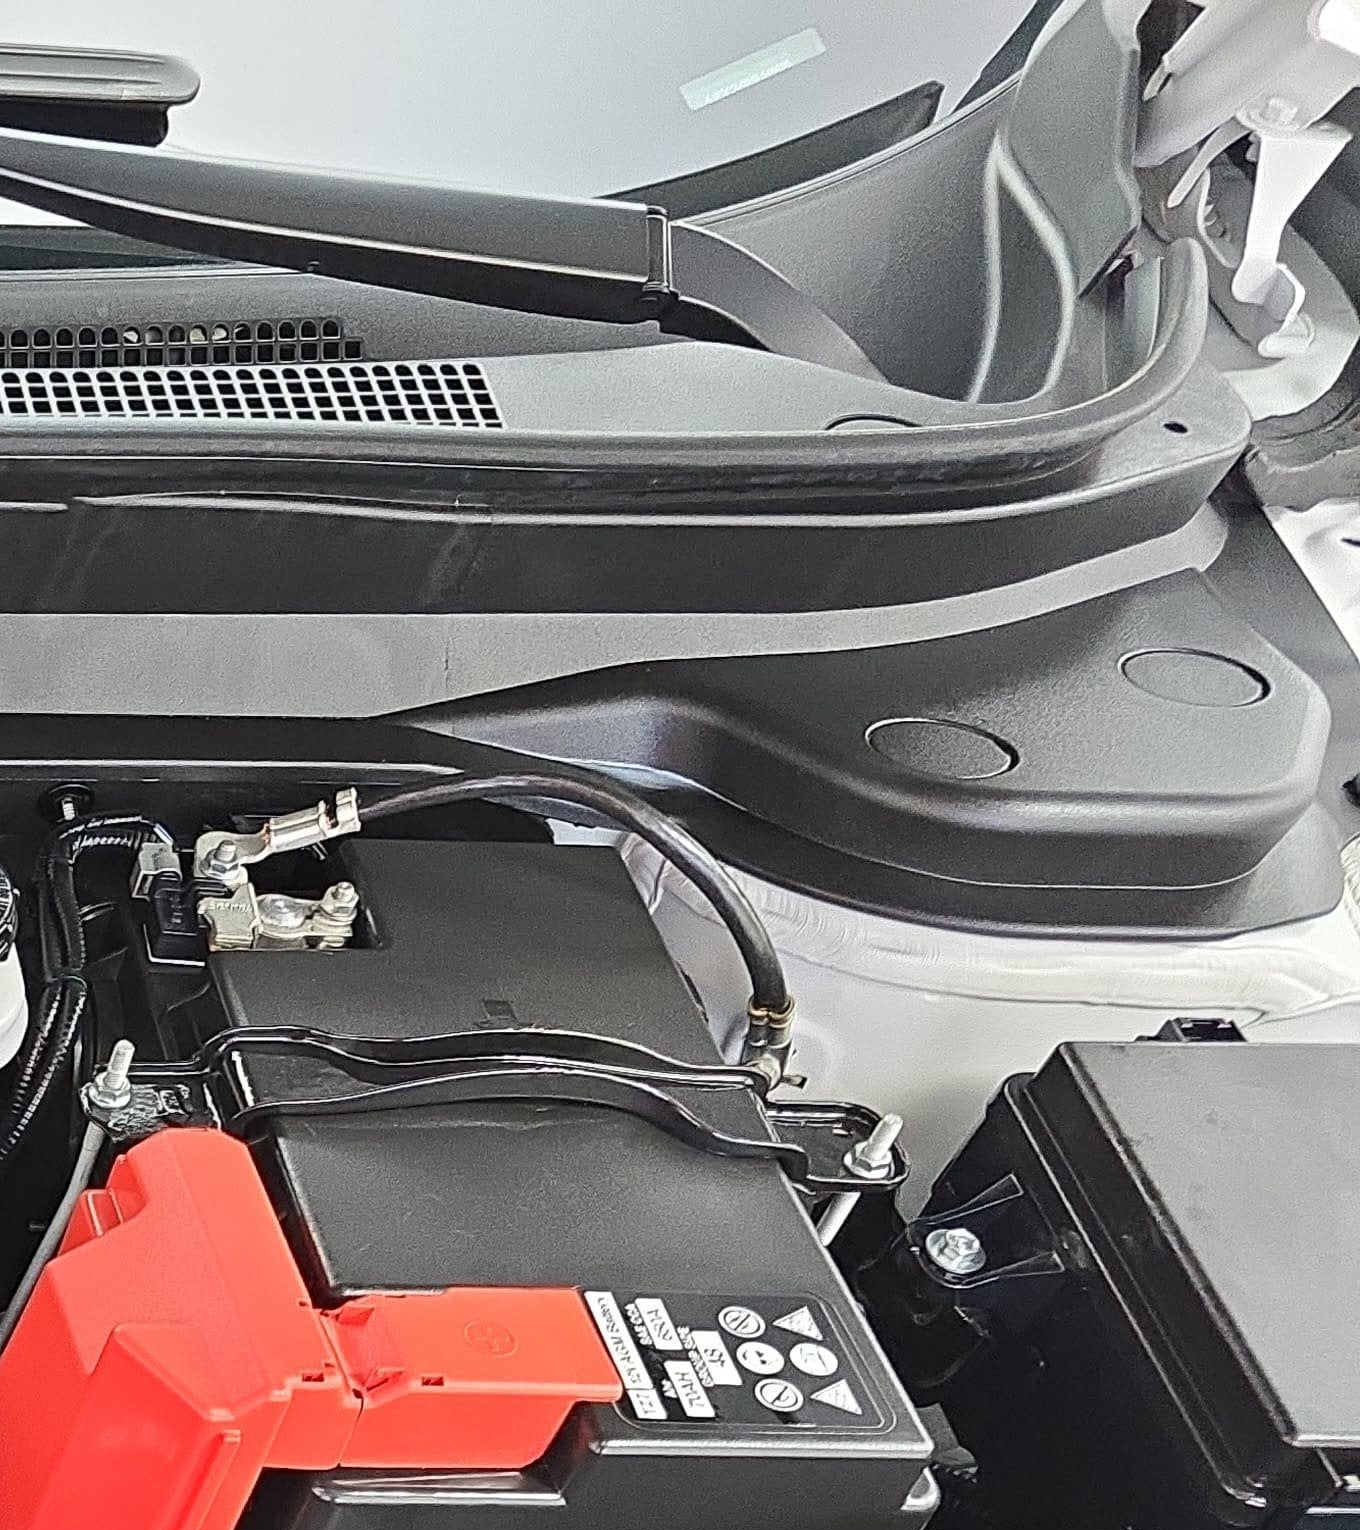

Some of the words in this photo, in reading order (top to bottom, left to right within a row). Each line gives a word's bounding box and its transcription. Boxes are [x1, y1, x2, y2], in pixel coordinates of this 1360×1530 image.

[596, 1297, 620, 1334] Battery
[610, 1335, 631, 1364] AGM
[687, 1349, 716, 1388] GROUP
